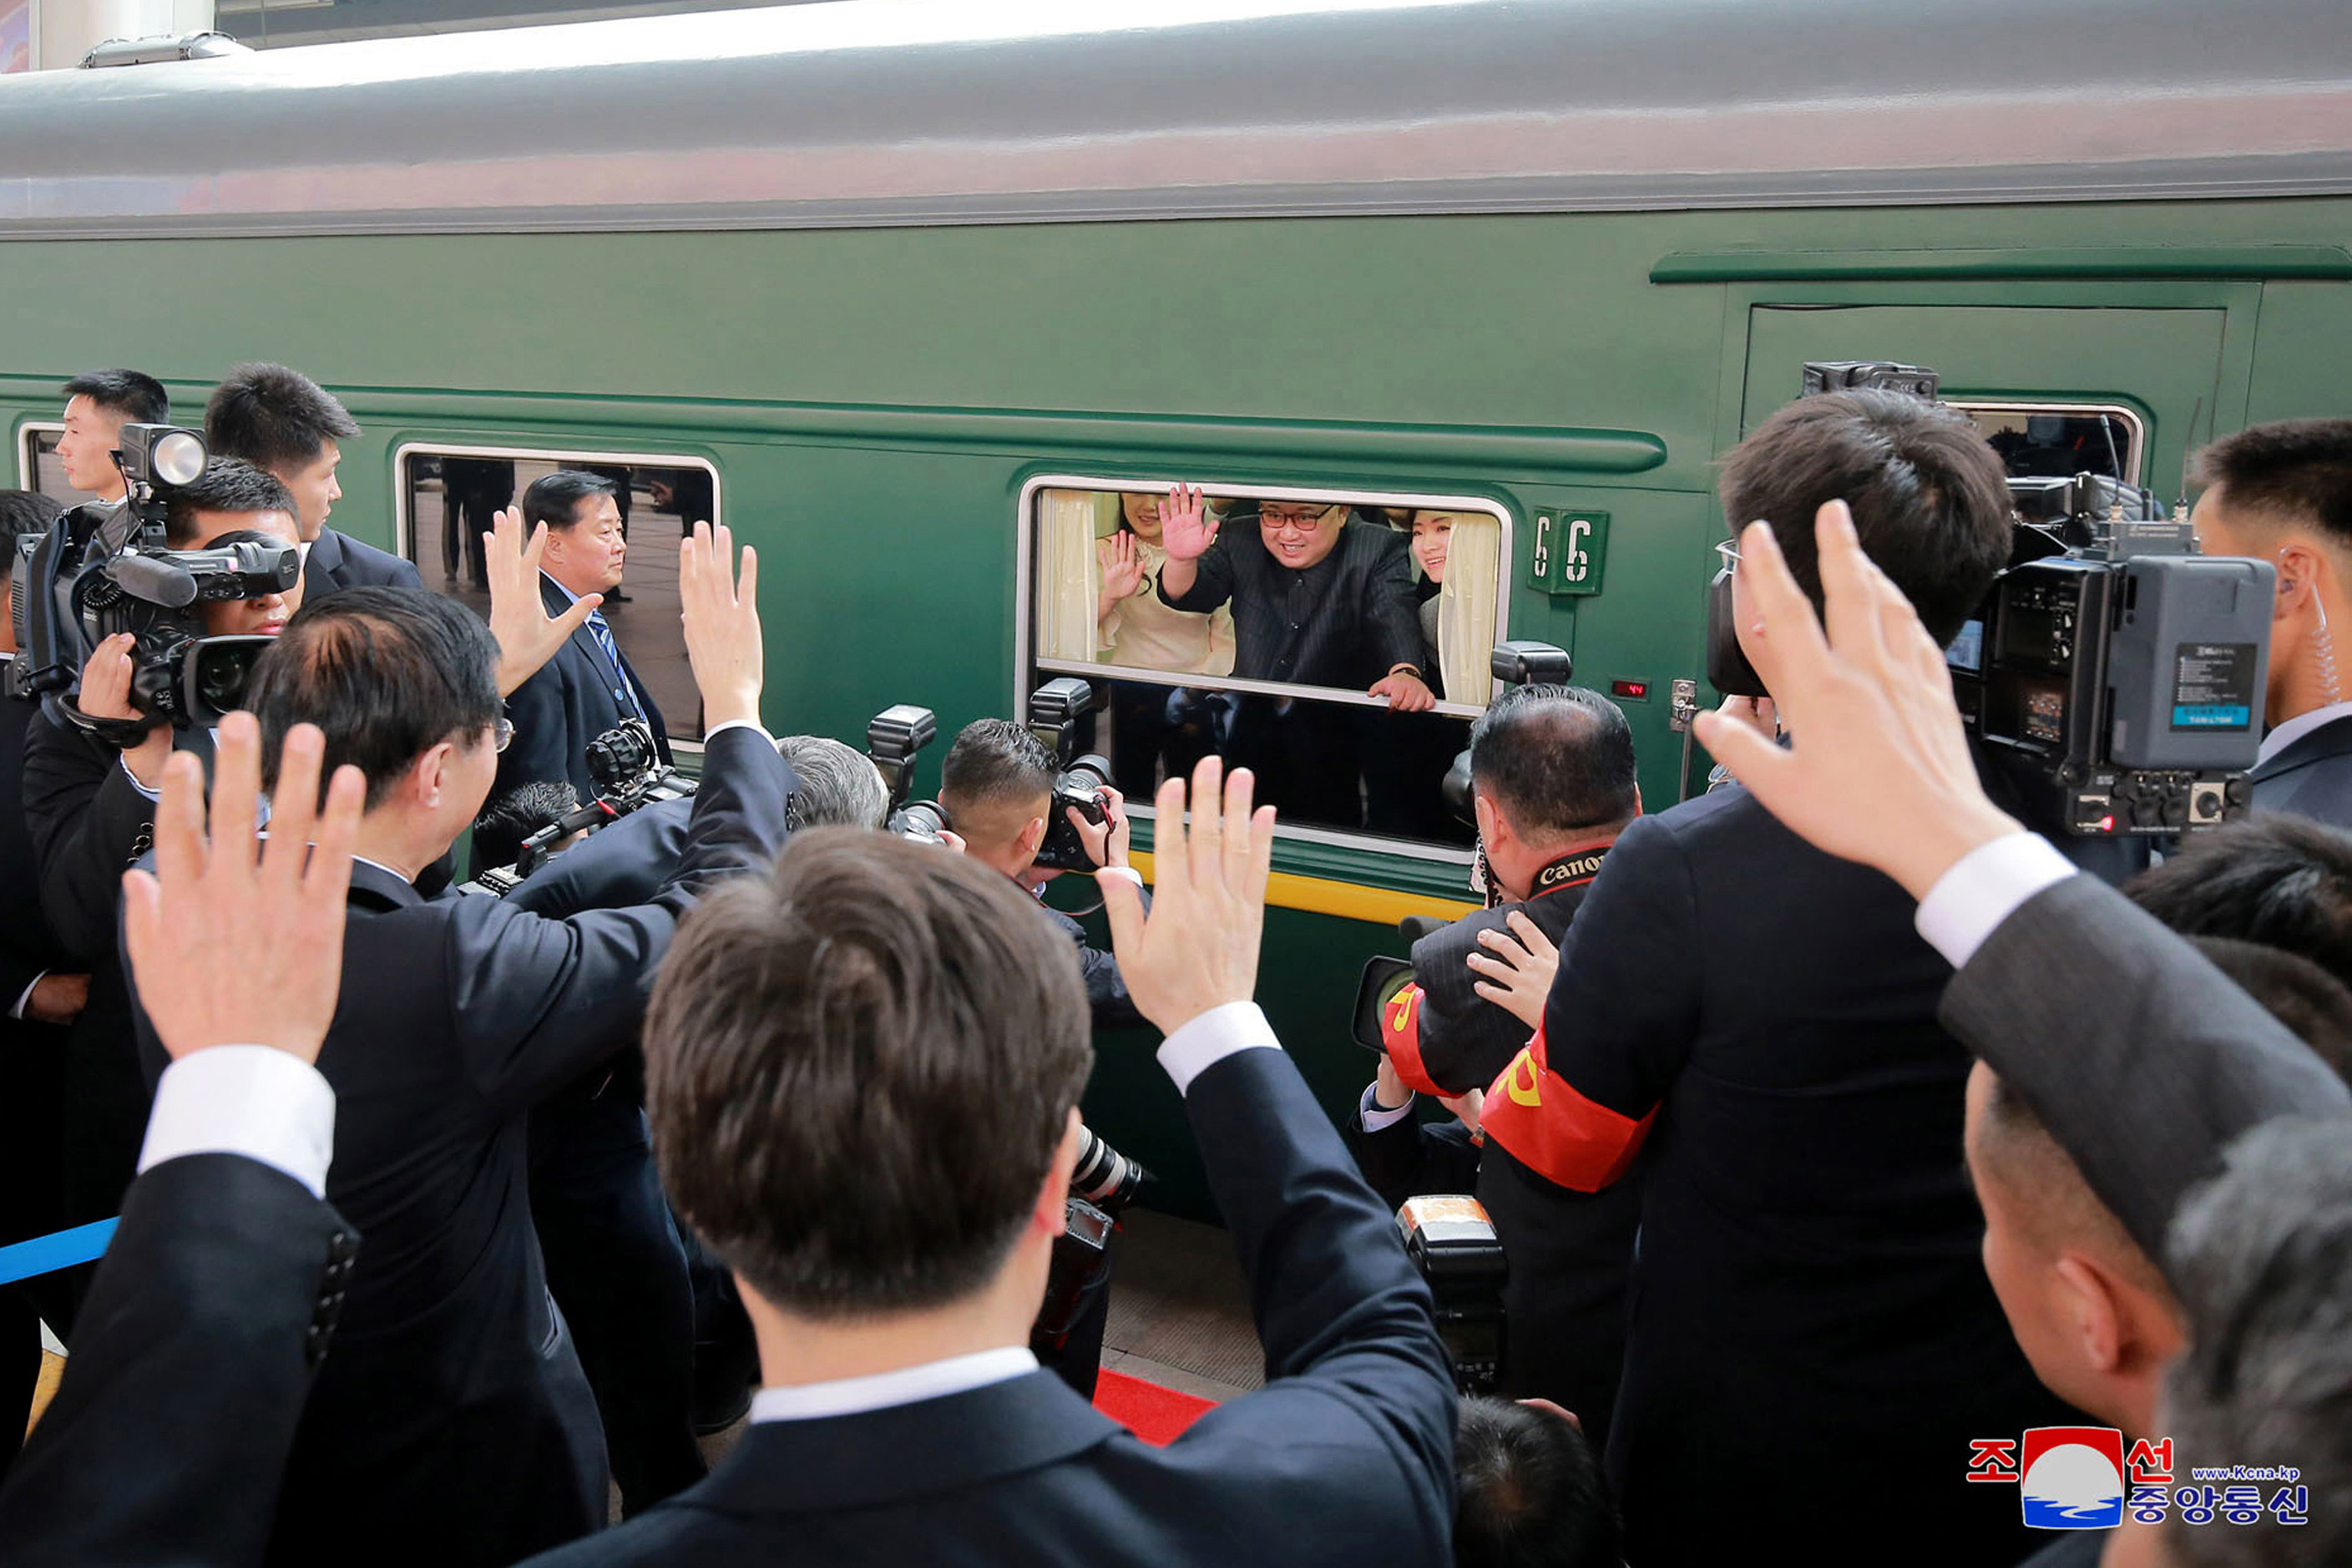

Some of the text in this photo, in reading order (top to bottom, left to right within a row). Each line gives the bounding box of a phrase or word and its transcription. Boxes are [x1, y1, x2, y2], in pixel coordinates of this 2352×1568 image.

[1534, 516, 1550, 578] 6
[1566, 520, 1592, 582] 6
[1540, 855, 1606, 885] Cano
